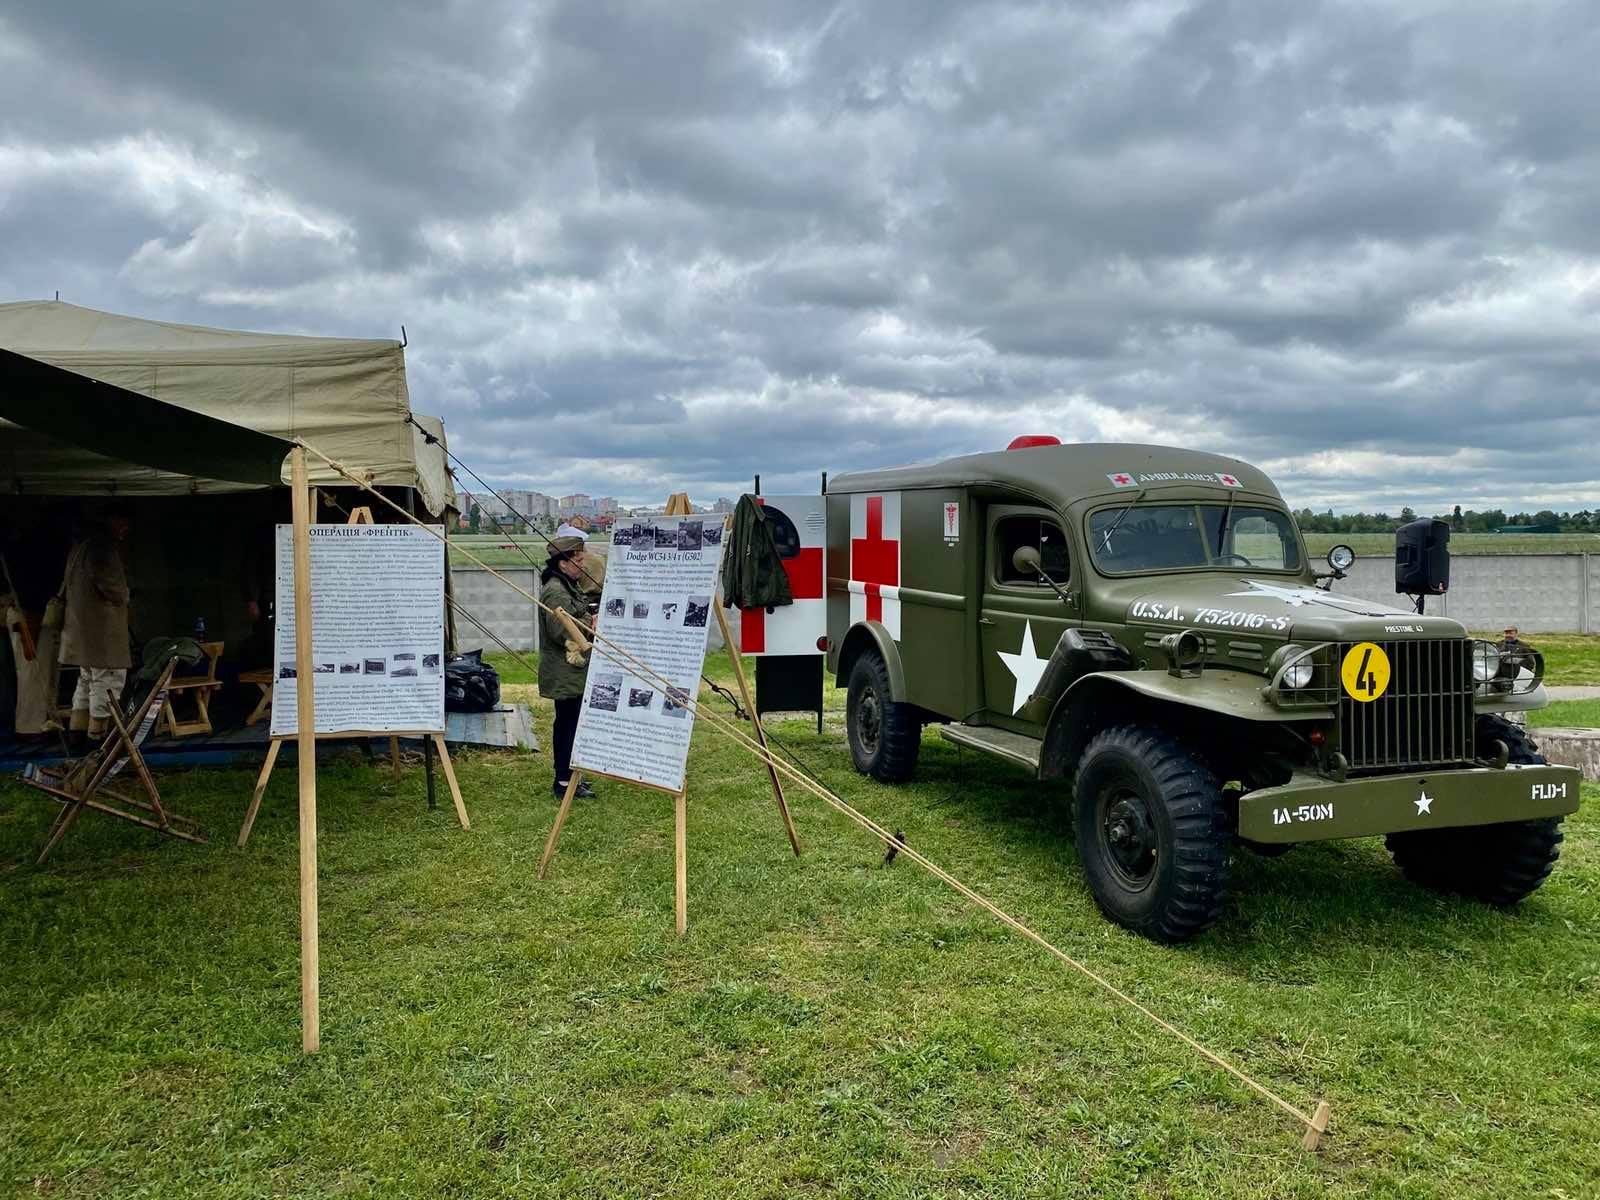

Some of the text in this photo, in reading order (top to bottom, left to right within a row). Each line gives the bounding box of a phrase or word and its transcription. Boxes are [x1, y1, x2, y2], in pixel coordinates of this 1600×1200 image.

[1139, 472, 1218, 483] AMBULANCE
[309, 529, 360, 537] ОПЕРАЦІЯ
[626, 551, 647, 563] Dodge
[1132, 601, 1290, 631] U.S.A. 752016-S
[1356, 649, 1376, 696] 4
[1531, 782, 1567, 799] FLD-1
[1272, 802, 1334, 825] 1A-50M
